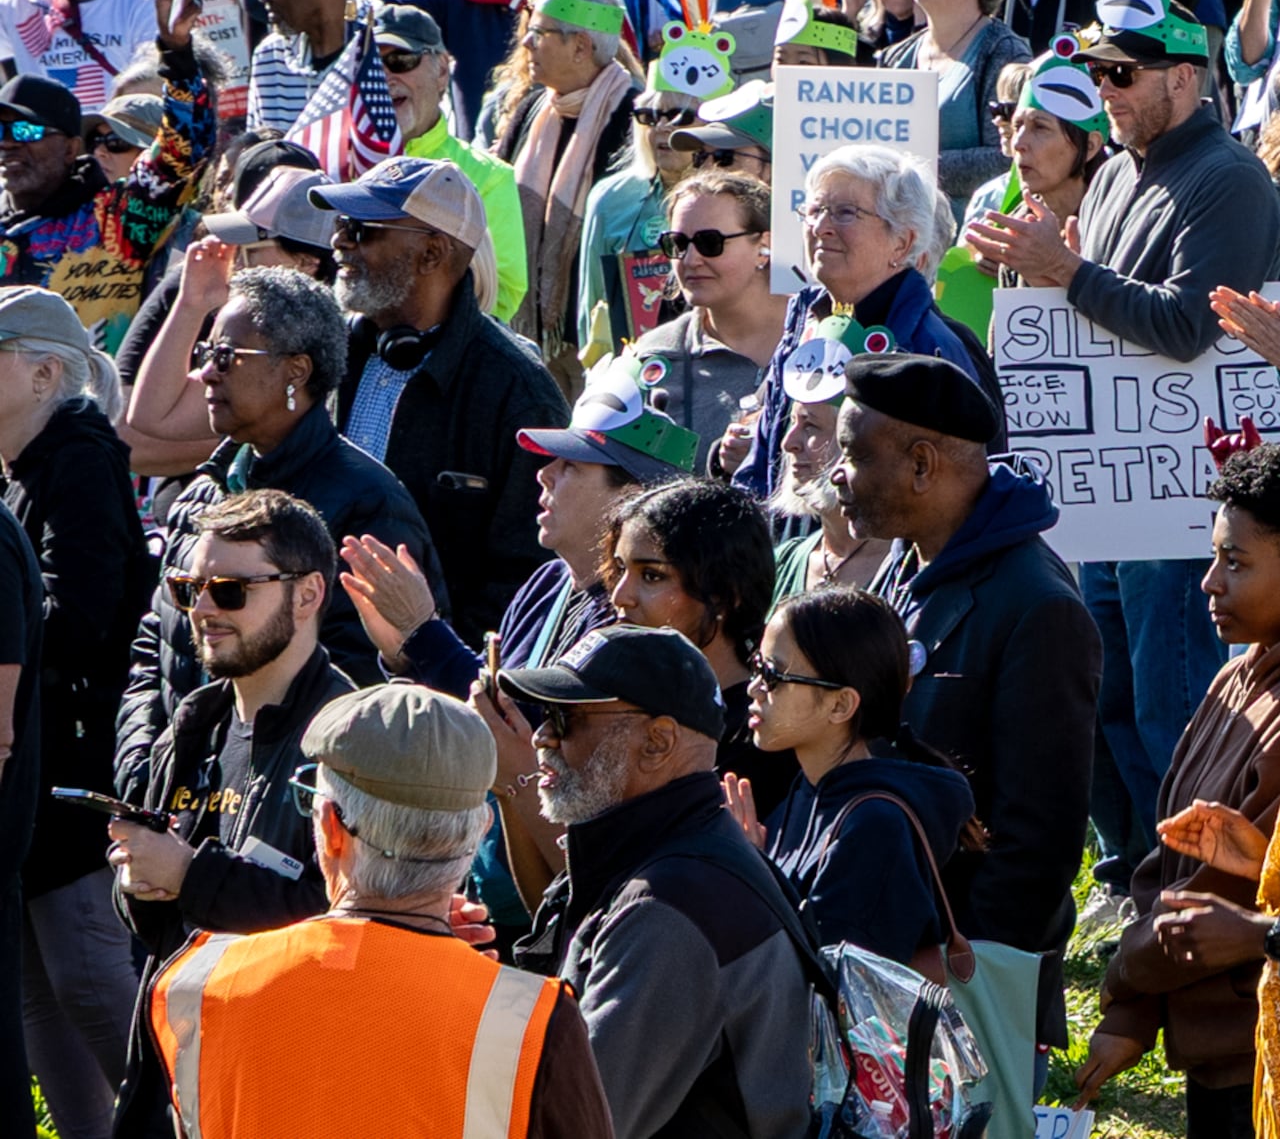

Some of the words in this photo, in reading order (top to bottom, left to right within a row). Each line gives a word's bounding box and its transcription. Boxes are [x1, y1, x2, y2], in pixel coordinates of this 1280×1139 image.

[104, 34, 122, 47] IN
[798, 80, 915, 105] RANKED
[800, 117, 910, 142] CHOICE
[64, 260, 102, 280] YOUR
[1000, 374, 1065, 388] I.C.E.
[1000, 392, 1067, 406] OUT
[1114, 373, 1200, 433] IS
[1005, 411, 1071, 428] NOW
